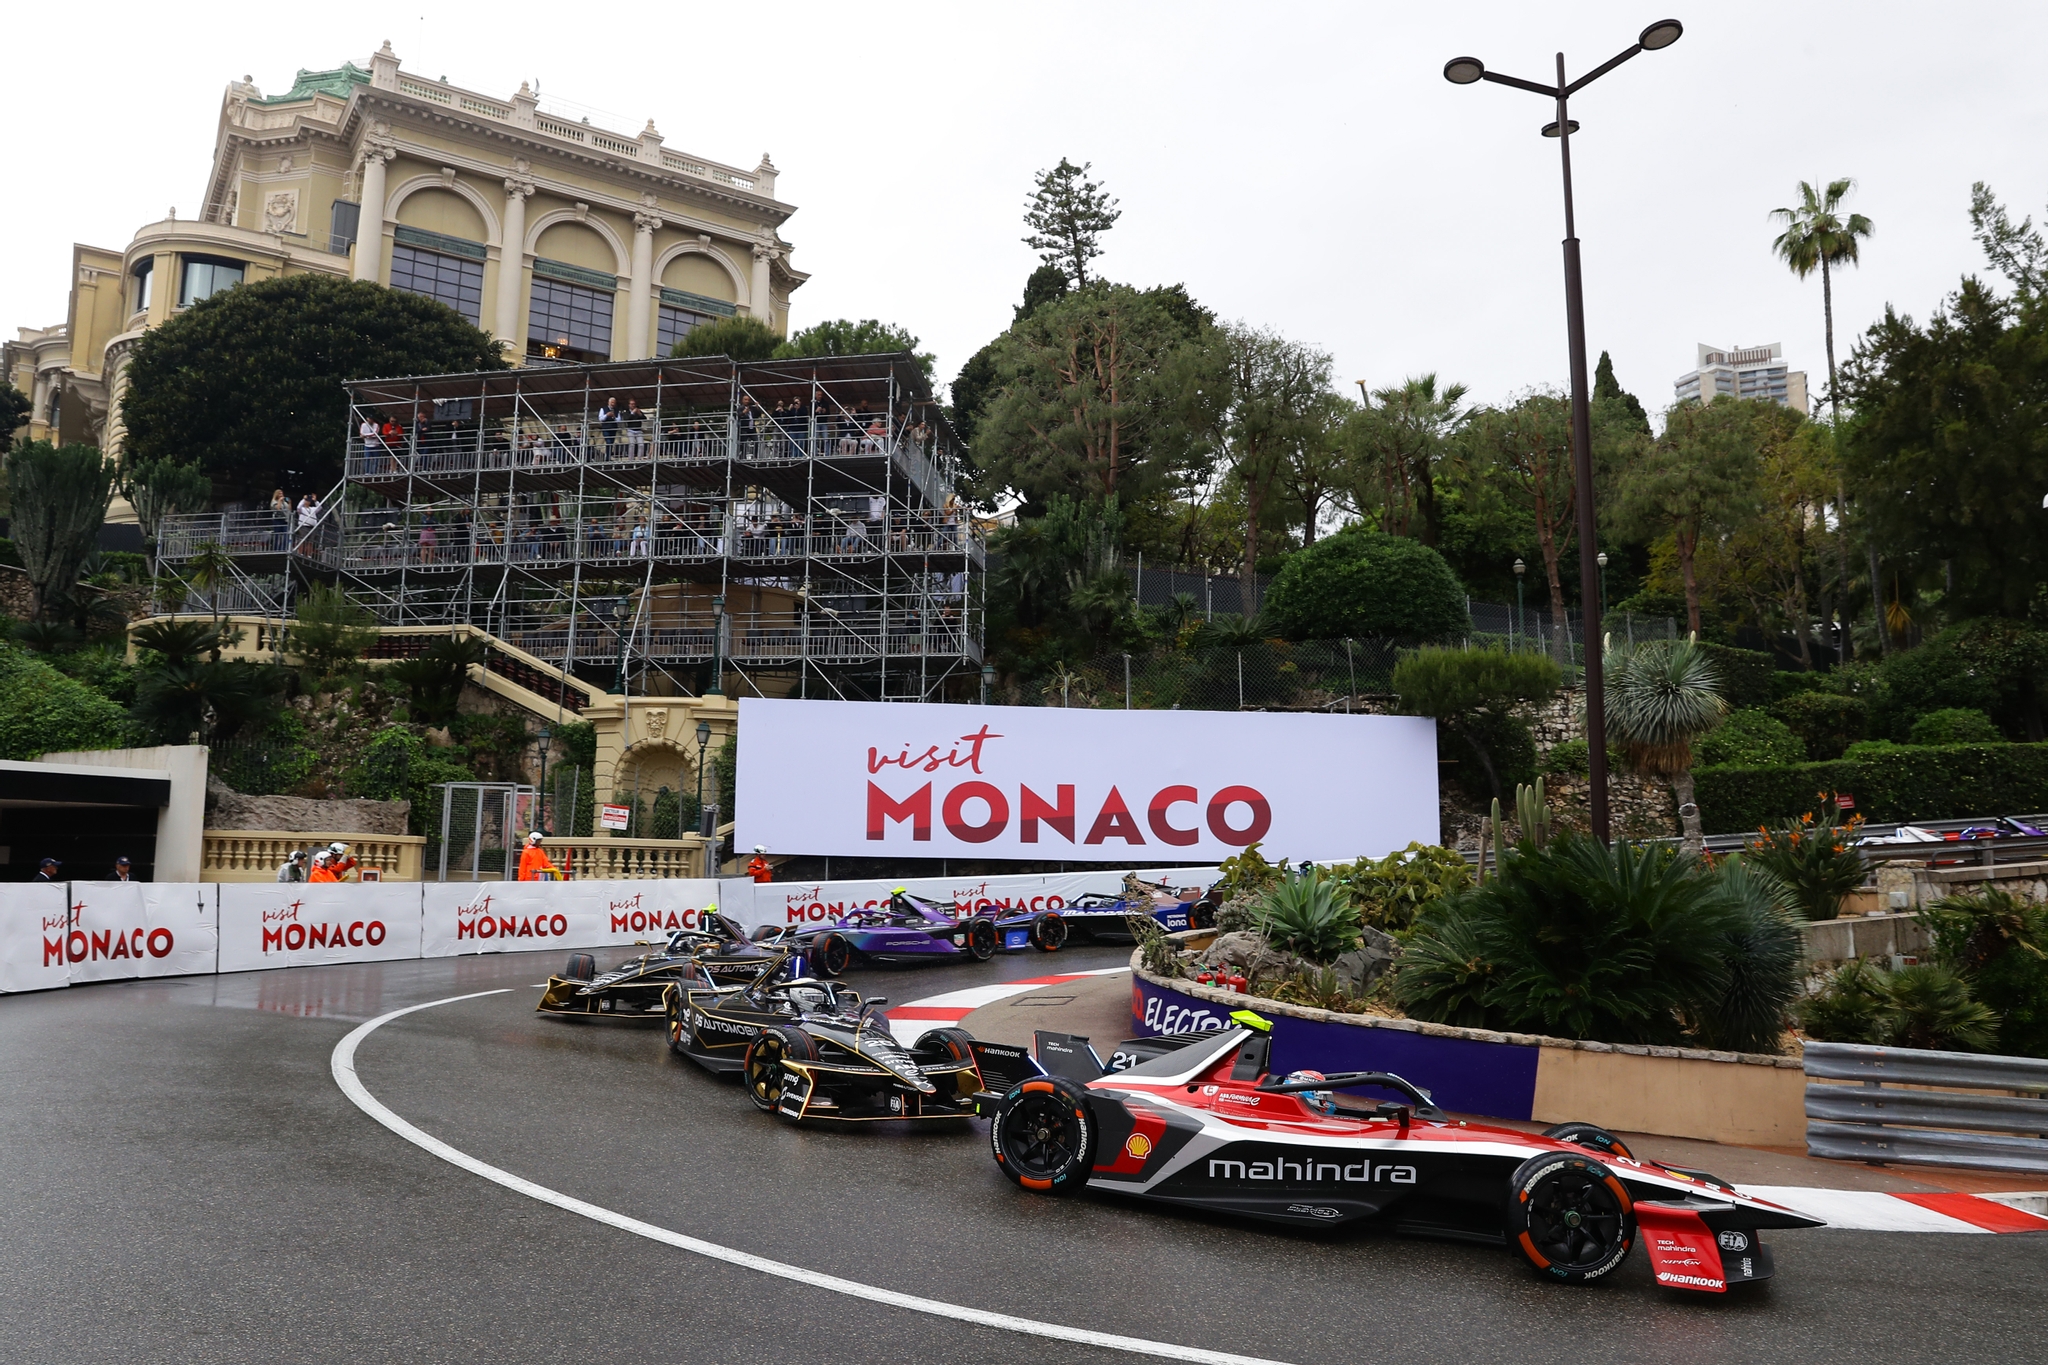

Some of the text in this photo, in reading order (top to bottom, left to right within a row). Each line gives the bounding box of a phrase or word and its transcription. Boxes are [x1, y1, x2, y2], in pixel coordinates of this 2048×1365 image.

[867, 723, 1004, 774] visit
[866, 779, 1271, 846] MONACO
[610, 892, 643, 911] visit
[787, 886, 823, 903] visit
[953, 882, 989, 898] visit
[43, 900, 88, 931] visit
[263, 899, 305, 923] visit
[458, 895, 496, 917] visit
[954, 895, 1064, 917] MONACO
[262, 921, 387, 952] MONACO
[458, 914, 568, 940] MONACO
[43, 928, 174, 967] MONACO
[1046, 1046, 1073, 1054] mahindra
[1112, 1051, 1137, 1070] 21
[1209, 1157, 1418, 1184] mahindra
[1719, 1233, 1746, 1250] FIA
